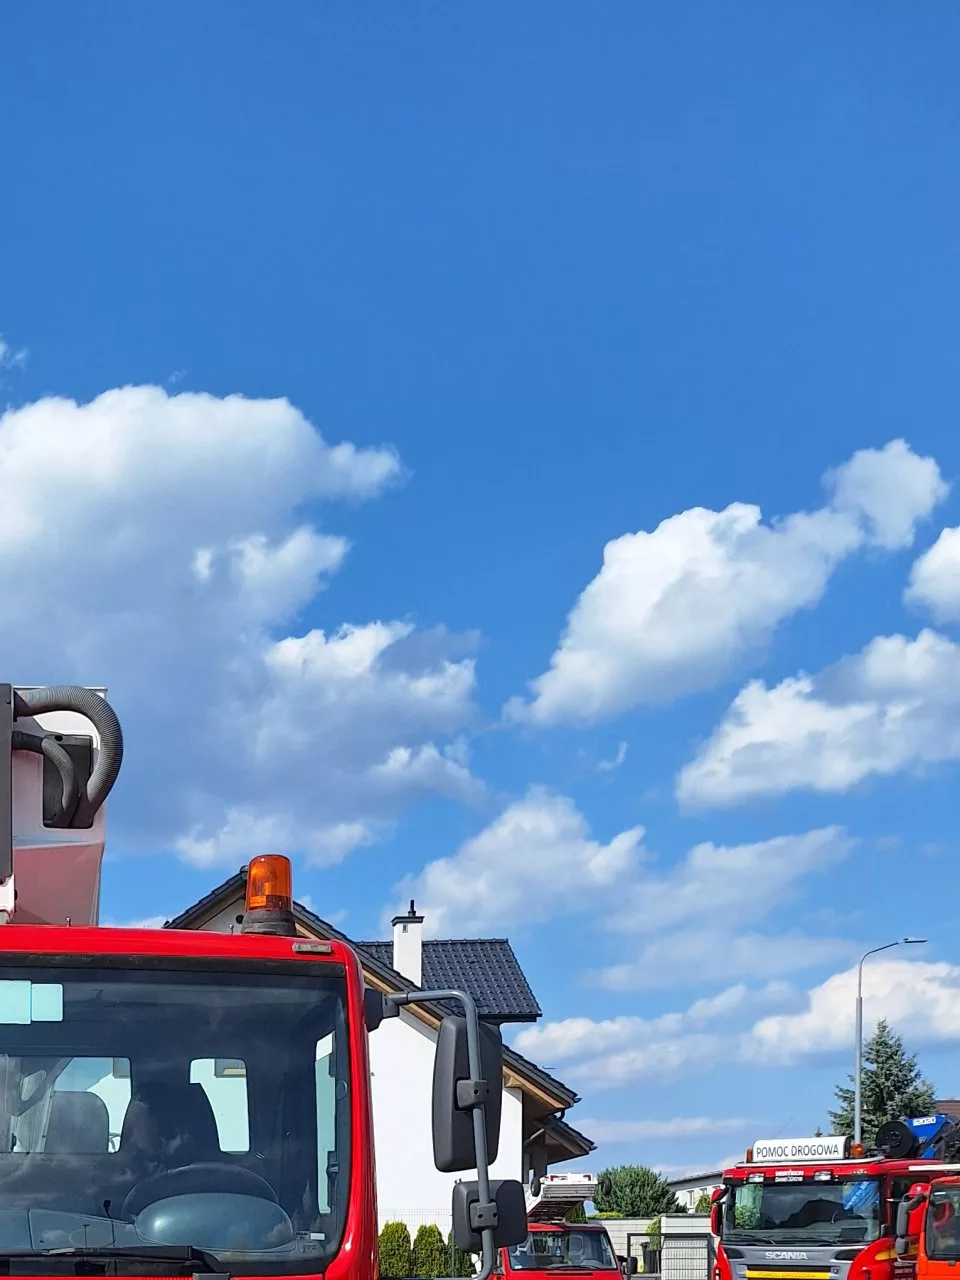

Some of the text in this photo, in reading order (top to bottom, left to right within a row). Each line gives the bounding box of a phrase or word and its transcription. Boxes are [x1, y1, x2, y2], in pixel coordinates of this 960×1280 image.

[756, 1143, 839, 1158] POMOC DROGOWA
[764, 1251, 809, 1260] SCANIA
